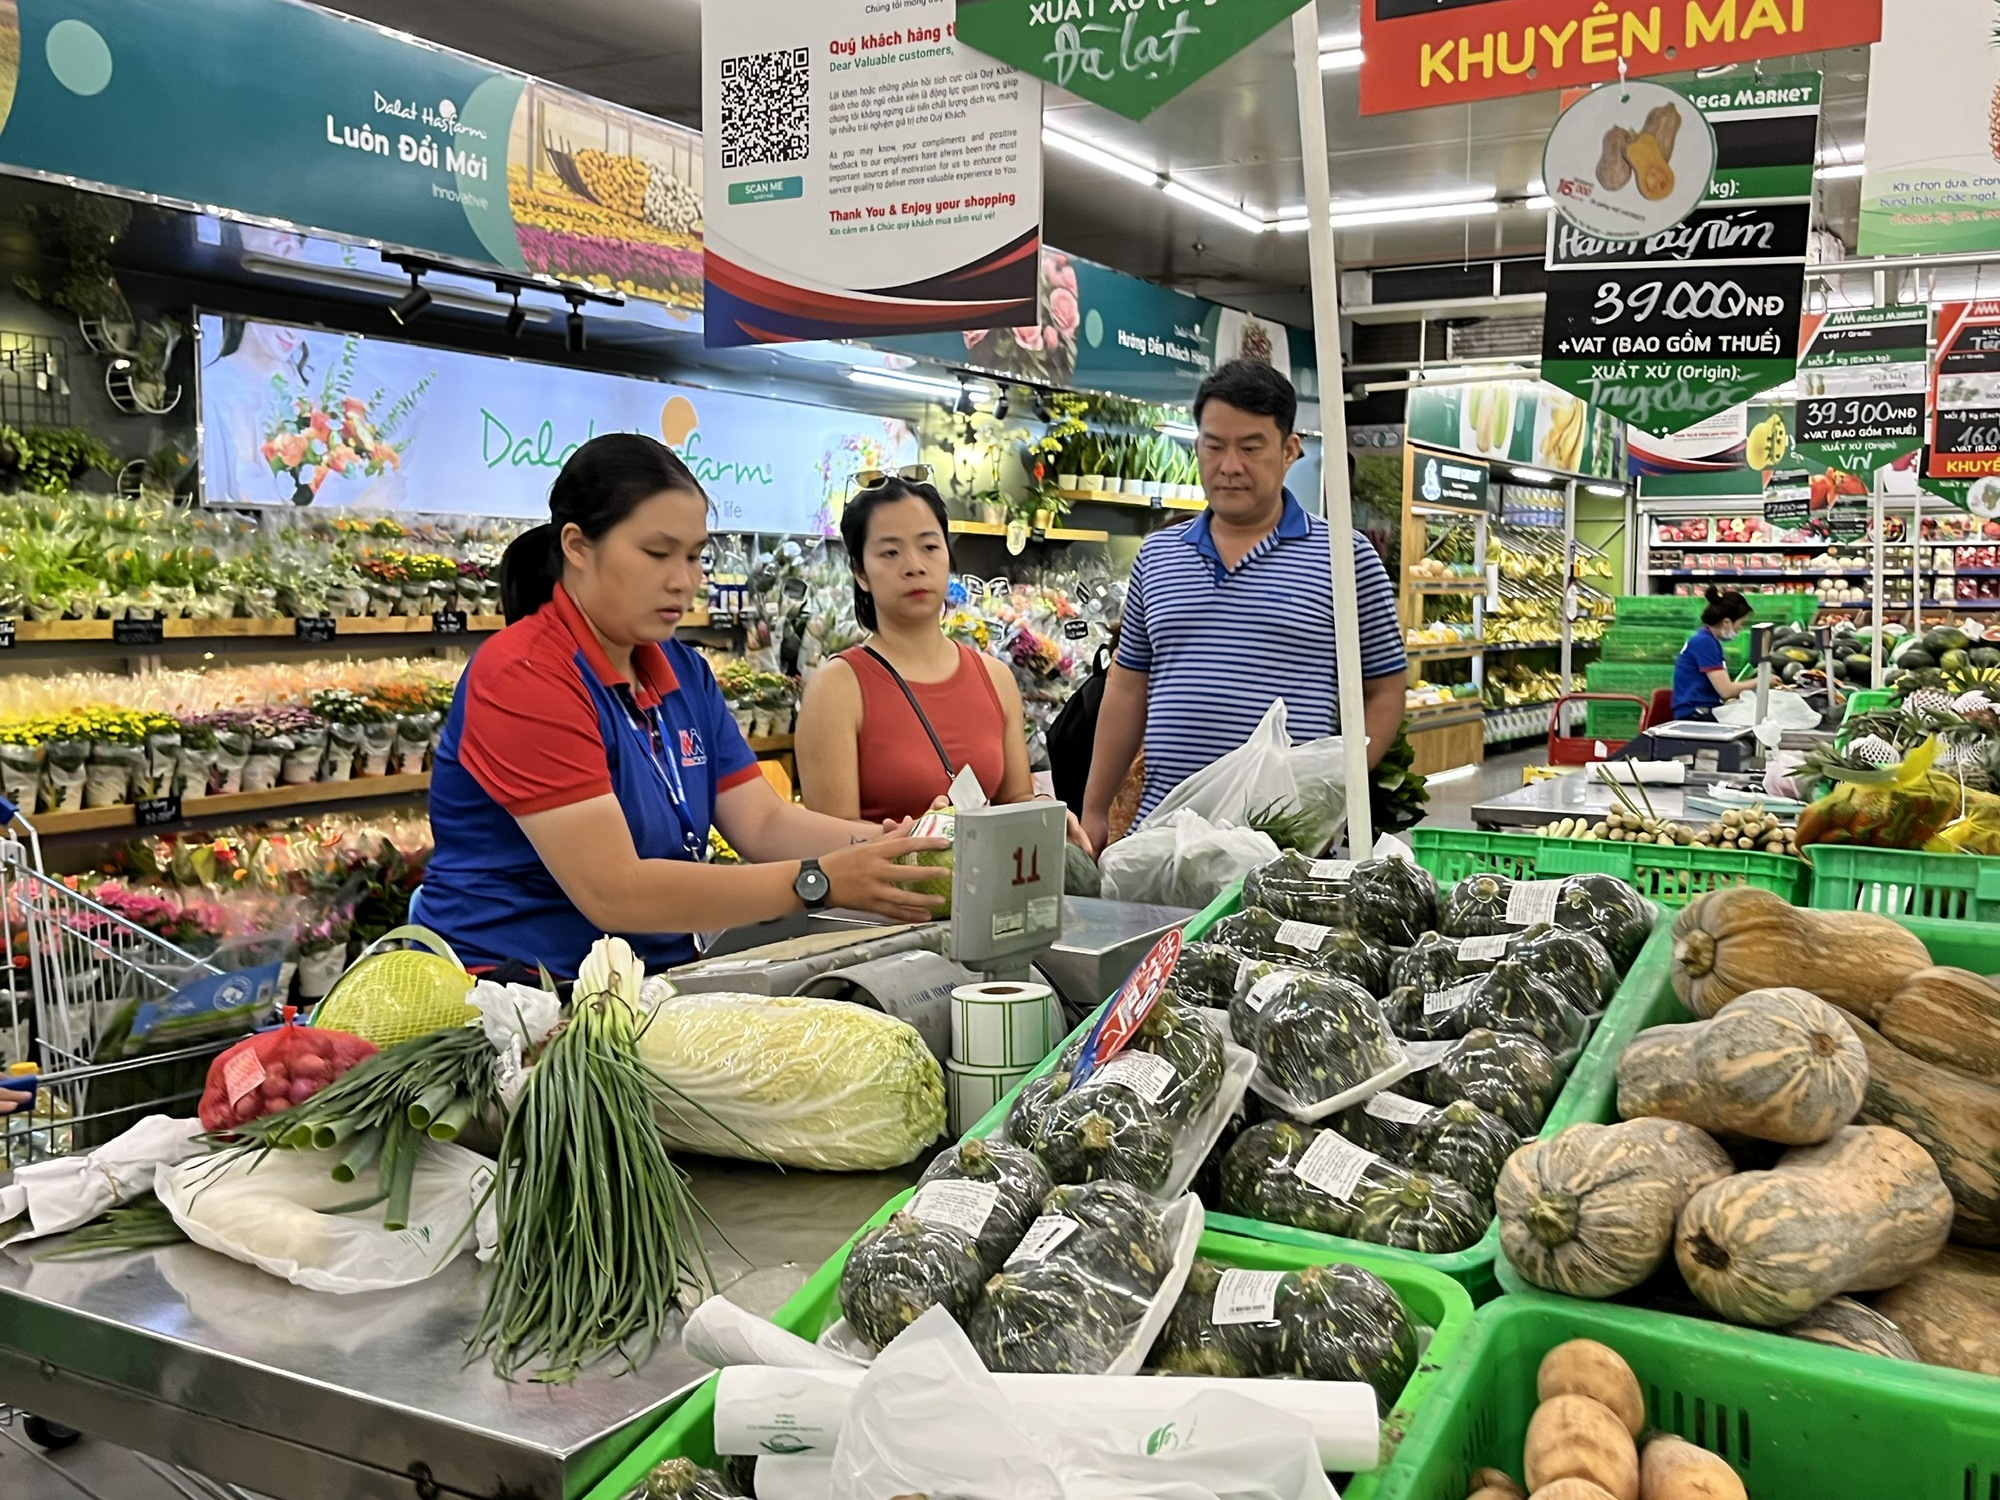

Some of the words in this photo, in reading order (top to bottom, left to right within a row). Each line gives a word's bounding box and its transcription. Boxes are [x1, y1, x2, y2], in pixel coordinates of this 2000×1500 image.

[830, 37, 856, 55] Quý
[861, 30, 902, 50] khách
[907, 27, 941, 43] hàng
[829, 61, 852, 72] Dear
[854, 54, 896, 69] Valuable
[898, 46, 954, 62] customers,
[373, 90, 418, 120] Dalat
[422, 107, 487, 139] Hasfarm
[326, 115, 390, 157] Luôn
[397, 134, 439, 169] Đổi
[445, 146, 488, 181] Mới
[829, 151, 838, 159] As
[843, 150, 855, 160] you
[859, 148, 873, 156] may
[902, 142, 917, 151] your
[922, 136, 966, 147] compliments
[971, 132, 985, 142] and
[989, 129, 1018, 141] positive
[829, 160, 858, 171] feedback
[861, 159, 868, 168] to
[870, 158, 881, 167] our
[883, 153, 919, 165] employees
[921, 151, 938, 160] have
[939, 148, 963, 158] always
[965, 145, 983, 155] been
[985, 143, 996, 152] the
[999, 141, 1017, 150] most
[829, 173, 860, 183] important
[863, 169, 888, 180] sources
[891, 166, 899, 176] of
[901, 163, 937, 175] motivation
[939, 161, 949, 170] for
[951, 161, 960, 169] us
[963, 160, 971, 168] to
[973, 156, 1002, 166] enhance
[1005, 154, 1017, 162] our
[829, 185, 852, 195] service
[853, 182, 875, 194] quality
[876, 181, 883, 190] to
[884, 179, 906, 189] deliver
[907, 177, 925, 186] more
[926, 173, 955, 183] valuable
[956, 169, 993, 181] experience
[994, 168, 1002, 176] to
[745, 182, 769, 195] SCAN
[769, 181, 783, 191] ME
[1709, 178, 1740, 198] kg):
[829, 208, 862, 222] Thank
[865, 206, 885, 218] You
[889, 204, 897, 216] &
[901, 202, 932, 216] Enjoy
[935, 200, 961, 214] your
[964, 192, 1016, 209] shopping
[829, 227, 841, 236] Xin
[869, 223, 875, 232] &
[876, 222, 895, 231] Chúc
[911, 217, 934, 228] khách
[935, 217, 952, 225] mua
[970, 212, 983, 221] vui
[1558, 336, 1607, 354] +VAT
[1612, 335, 1660, 356] (BAO
[1665, 328, 1712, 353] GỒM
[1718, 327, 1782, 355] THUẾ)
[1591, 359, 1640, 380] XUẤT
[1676, 364, 1742, 383] (Origin):
[1806, 400, 1892, 427] 39.900
[1889, 407, 1918, 419] VNĐ
[1831, 429, 1856, 440] (BAO
[1974, 445, 1997, 453] (BAO
[723, 501, 743, 518] life
[1011, 843, 1041, 887] 11
